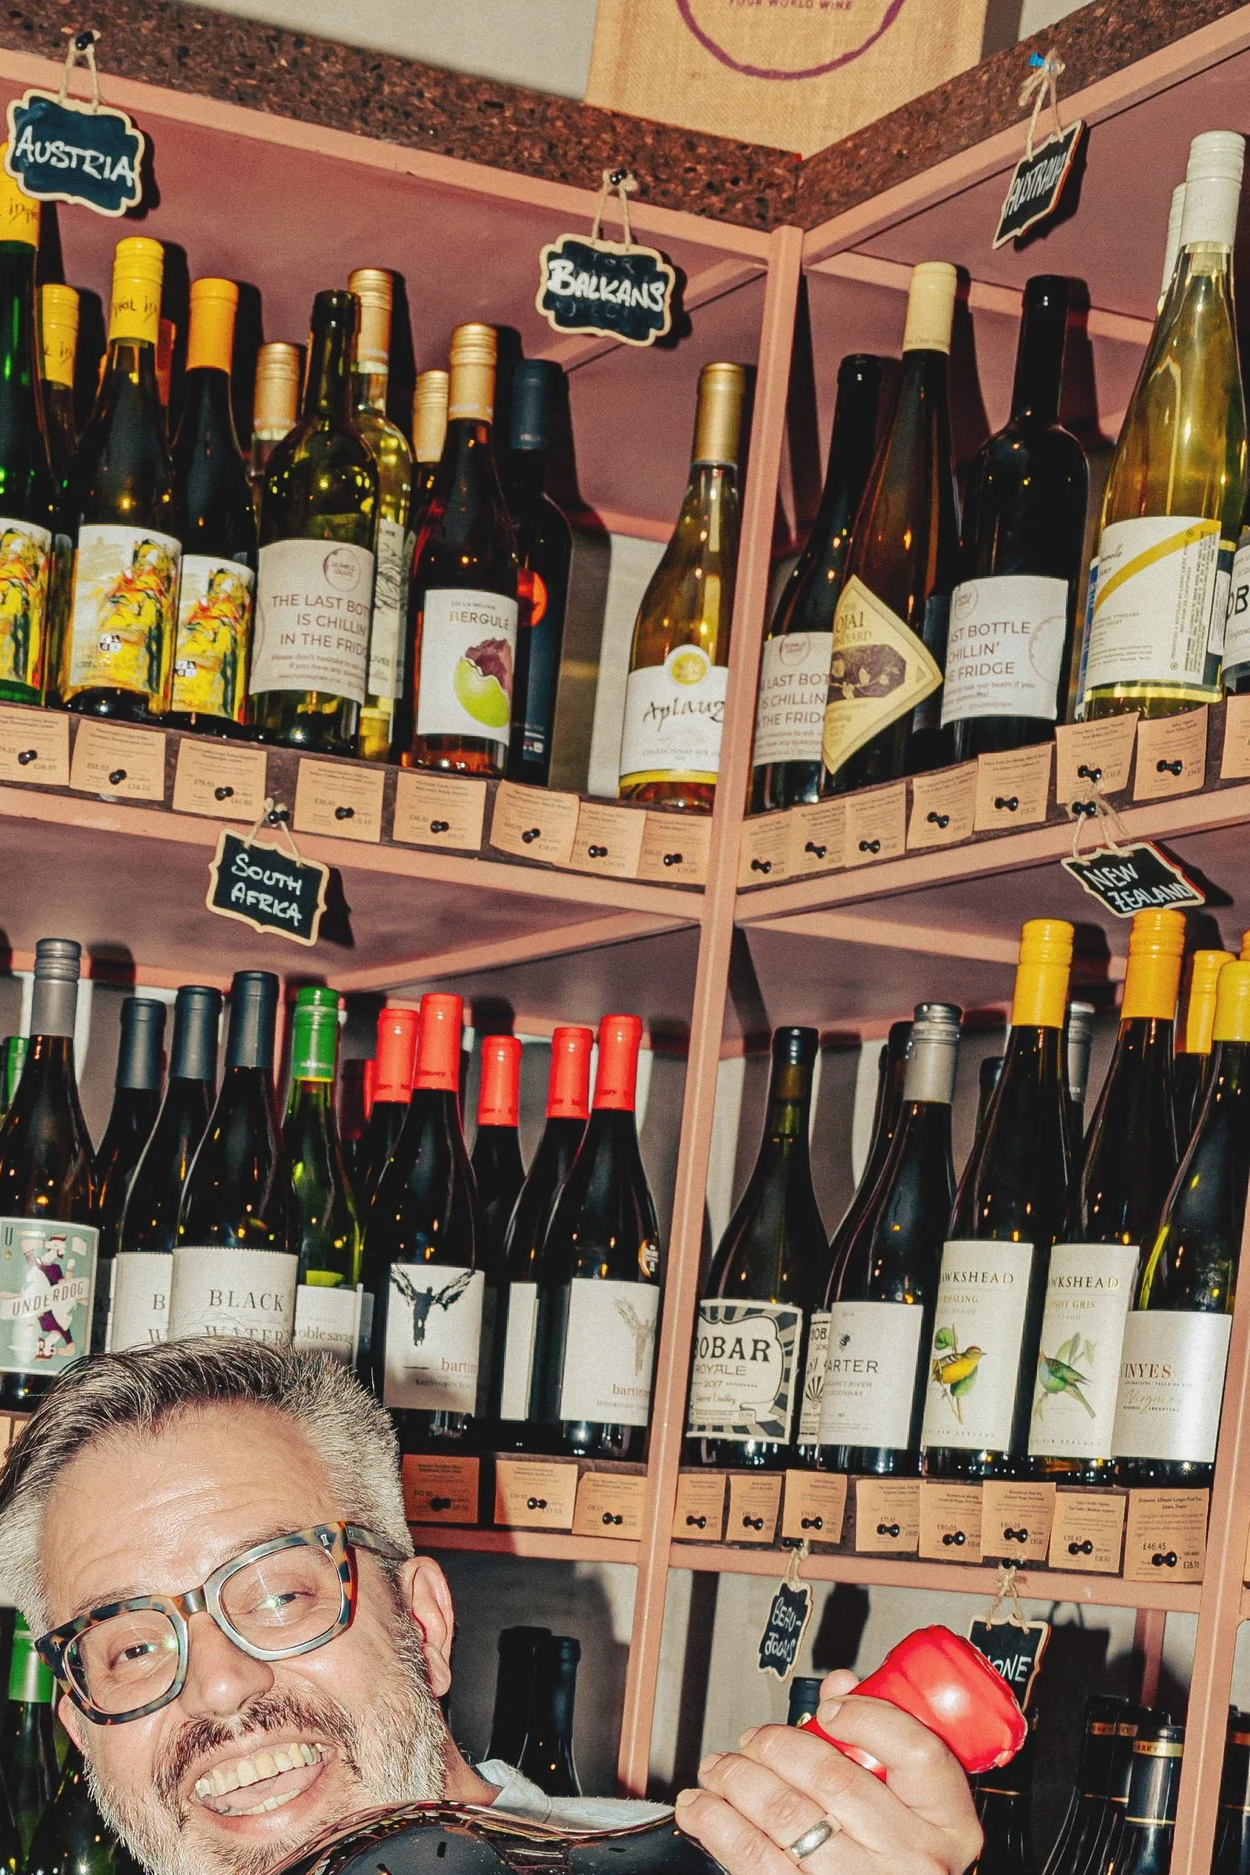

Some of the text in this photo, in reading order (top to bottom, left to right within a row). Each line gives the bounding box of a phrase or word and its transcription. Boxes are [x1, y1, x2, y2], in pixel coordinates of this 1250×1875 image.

[15, 125, 135, 187] AUSTRIA
[546, 258, 665, 312] BALKANS
[271, 594, 370, 617] THE LAST BOT
[297, 613, 311, 626] IS
[967, 621, 1031, 638] BOTTLE
[280, 634, 296, 645] IN
[301, 633, 332, 648] THE
[798, 672, 831, 687] BOT
[958, 661, 1015, 680] FRIDGE
[785, 711, 826, 725] FRID
[231, 853, 302, 896] SOUTH
[1083, 863, 1139, 891] NEW
[231, 881, 303, 927] AFRICA
[1107, 882, 1194, 912] ZEALAND
[4, 1227, 13, 1246] U
[12, 1281, 84, 1317] UNDERDOG
[209, 1288, 285, 1312] BLACK
[1072, 1300, 1095, 1309] GRIS
[696, 1336, 771, 1362] OBAR
[1142, 1541, 1167, 1551] £46.45
[772, 1596, 802, 1632] BEAU-
[991, 1656, 1032, 1681] ONE
